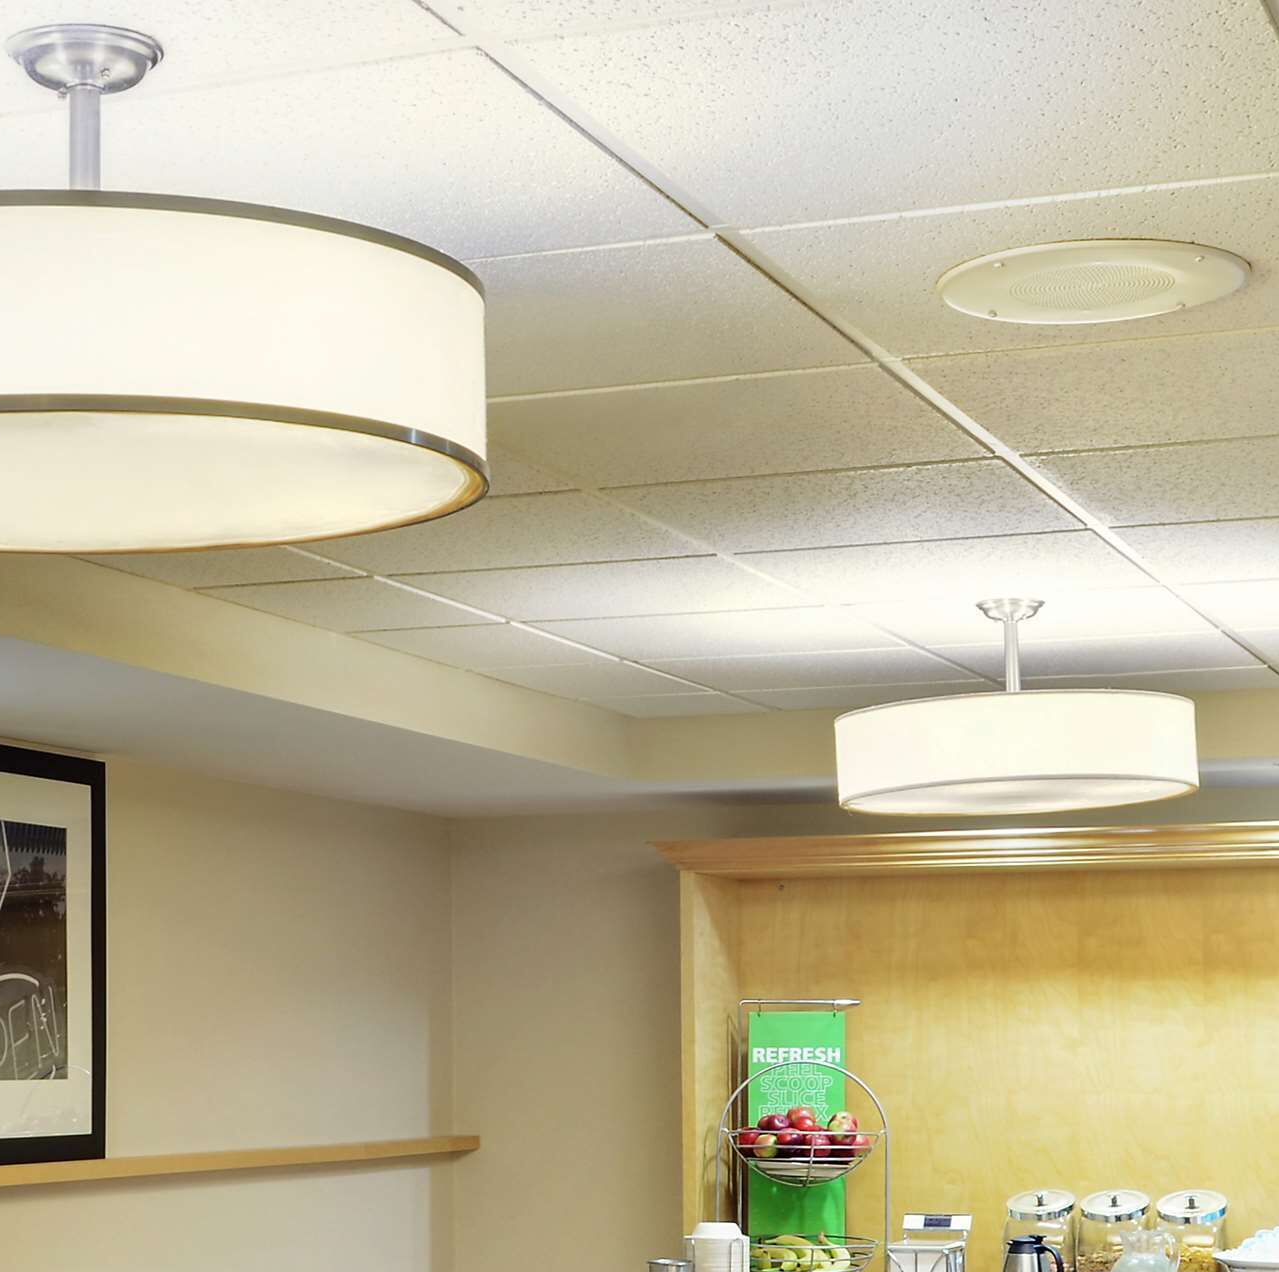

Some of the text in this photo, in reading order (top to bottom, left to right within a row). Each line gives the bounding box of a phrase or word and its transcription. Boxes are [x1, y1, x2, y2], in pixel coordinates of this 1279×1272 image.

[752, 1047, 841, 1063] REFRESH
[760, 1076, 833, 1092] SCOOP
[767, 1091, 826, 1106] SLICE
